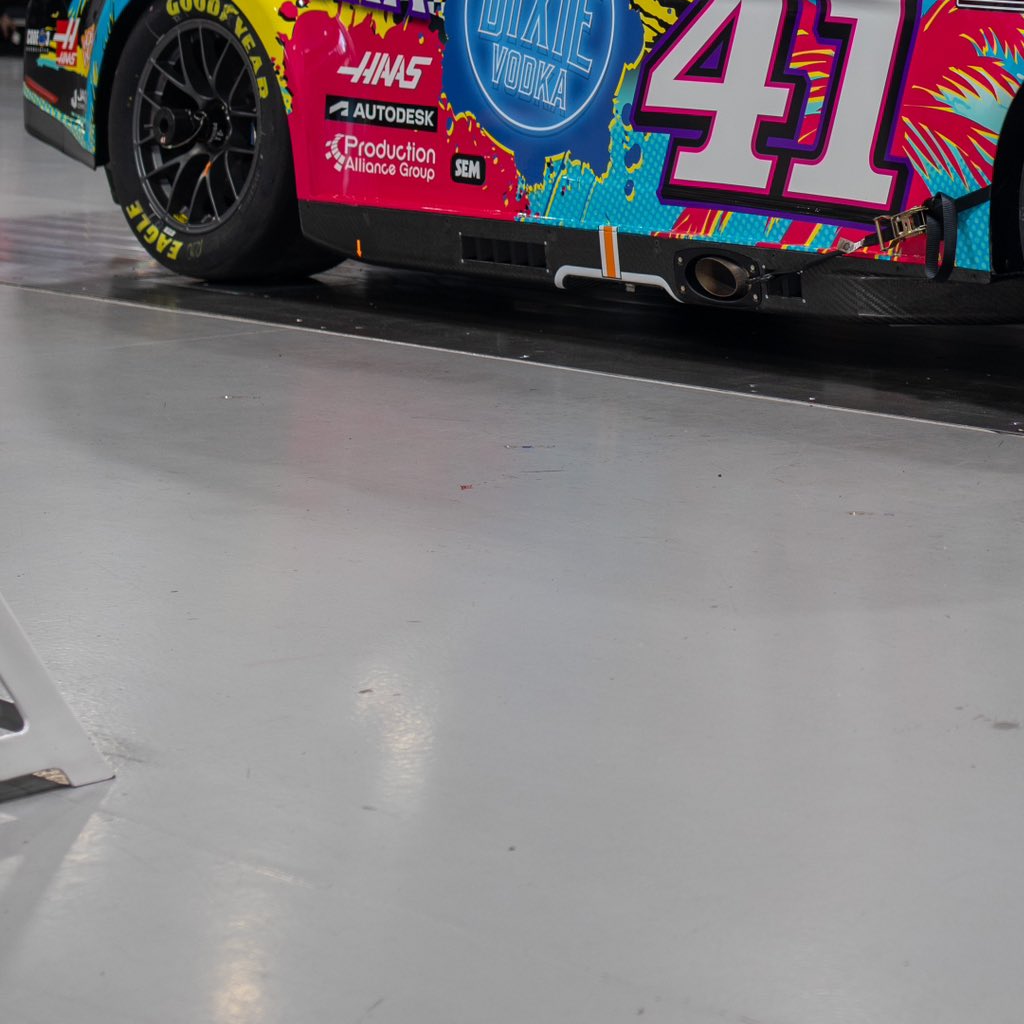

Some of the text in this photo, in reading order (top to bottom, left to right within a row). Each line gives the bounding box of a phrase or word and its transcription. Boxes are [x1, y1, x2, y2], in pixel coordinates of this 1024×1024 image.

[337, 51, 433, 90] HAAS
[491, 42, 568, 112] VODKA
[353, 102, 435, 127] AUTODESK
[344, 135, 436, 164] Production
[345, 156, 435, 182] Alliance Group
[455, 158, 481, 179] SEM
[125, 200, 184, 261] EAGLE
